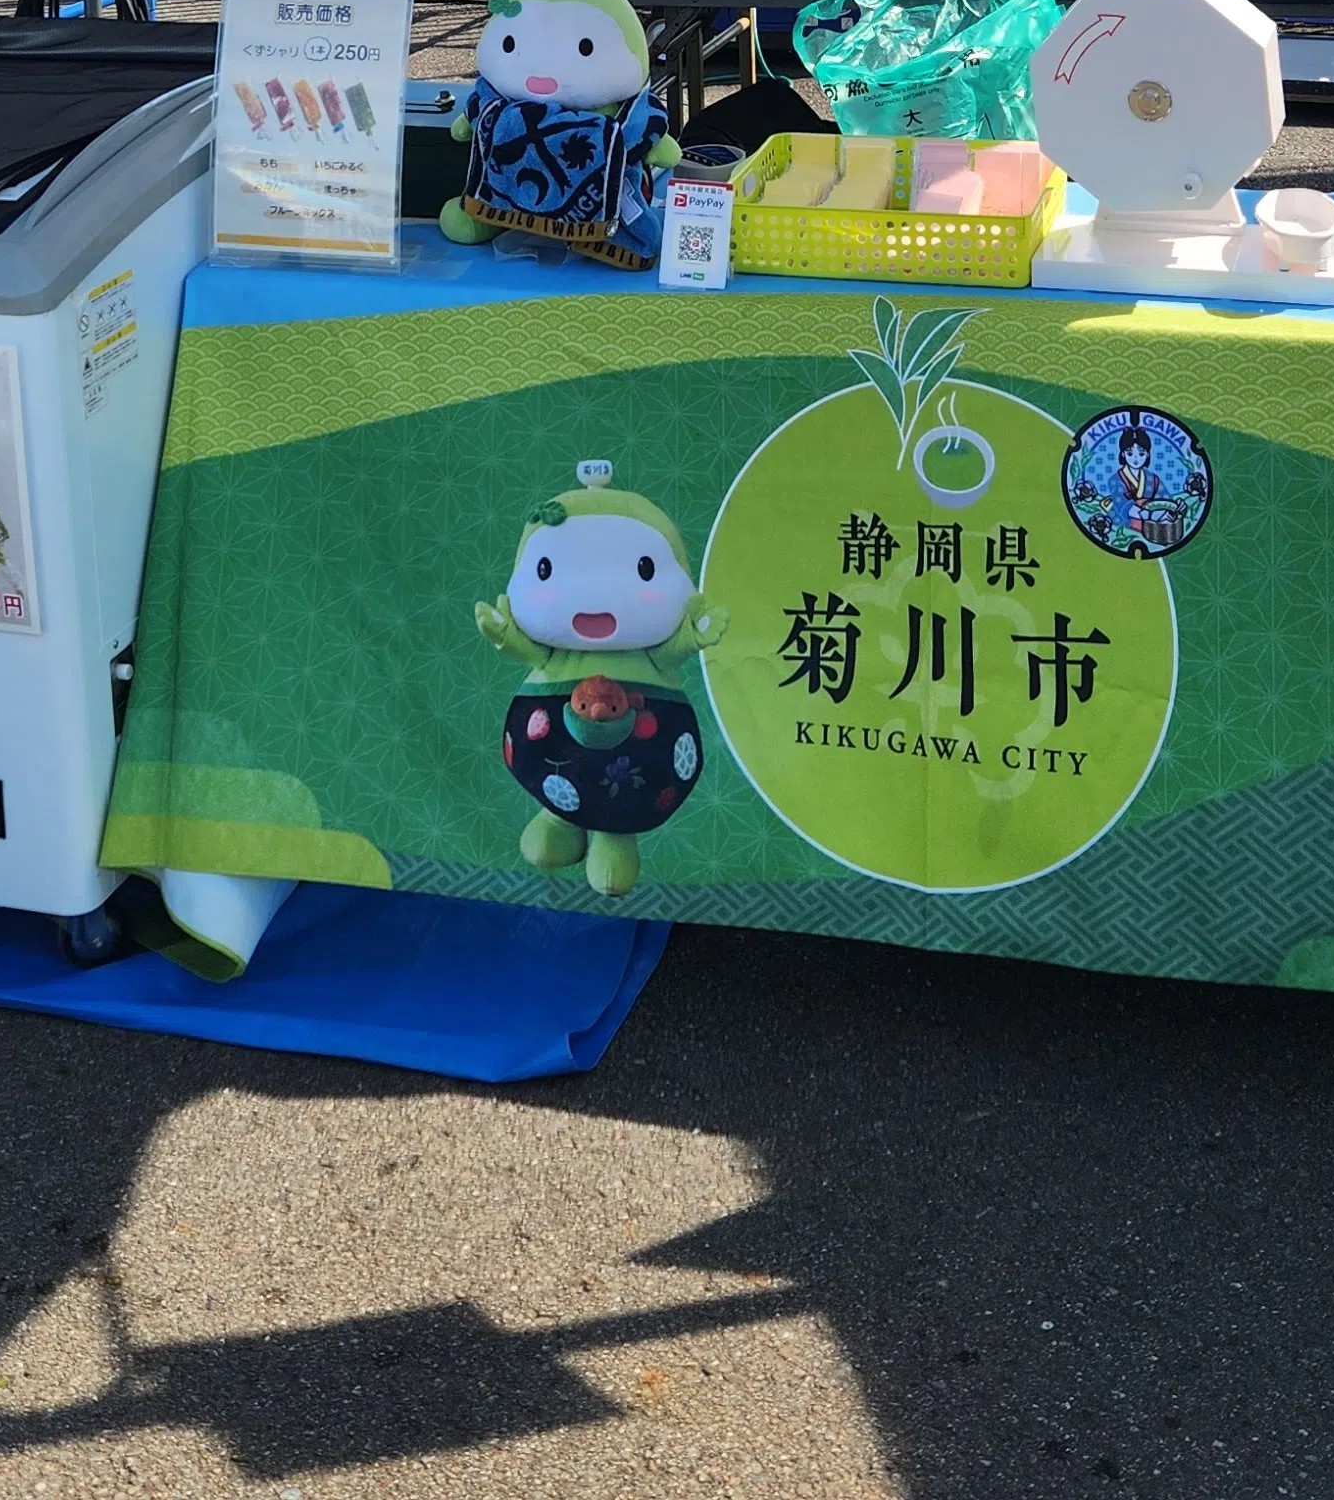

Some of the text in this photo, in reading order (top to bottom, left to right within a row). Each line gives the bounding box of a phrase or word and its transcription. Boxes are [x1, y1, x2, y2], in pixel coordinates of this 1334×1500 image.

[277, 2, 353, 24] 販売価格
[243, 42, 300, 58] くずシャリ
[333, 44, 381, 62] 250円
[259, 158, 364, 172] もも いちごみるく
[323, 184, 357, 196] まっちゃ
[688, 196, 725, 210] PayPay
[476, 204, 596, 238] JUBILO IWATA
[1087, 413, 1188, 448] KIKU GAWA
[836, 512, 1041, 593] 静岡県
[776, 590, 1111, 729] 菊川市
[794, 720, 1090, 777] KIKUGAWA CITY
